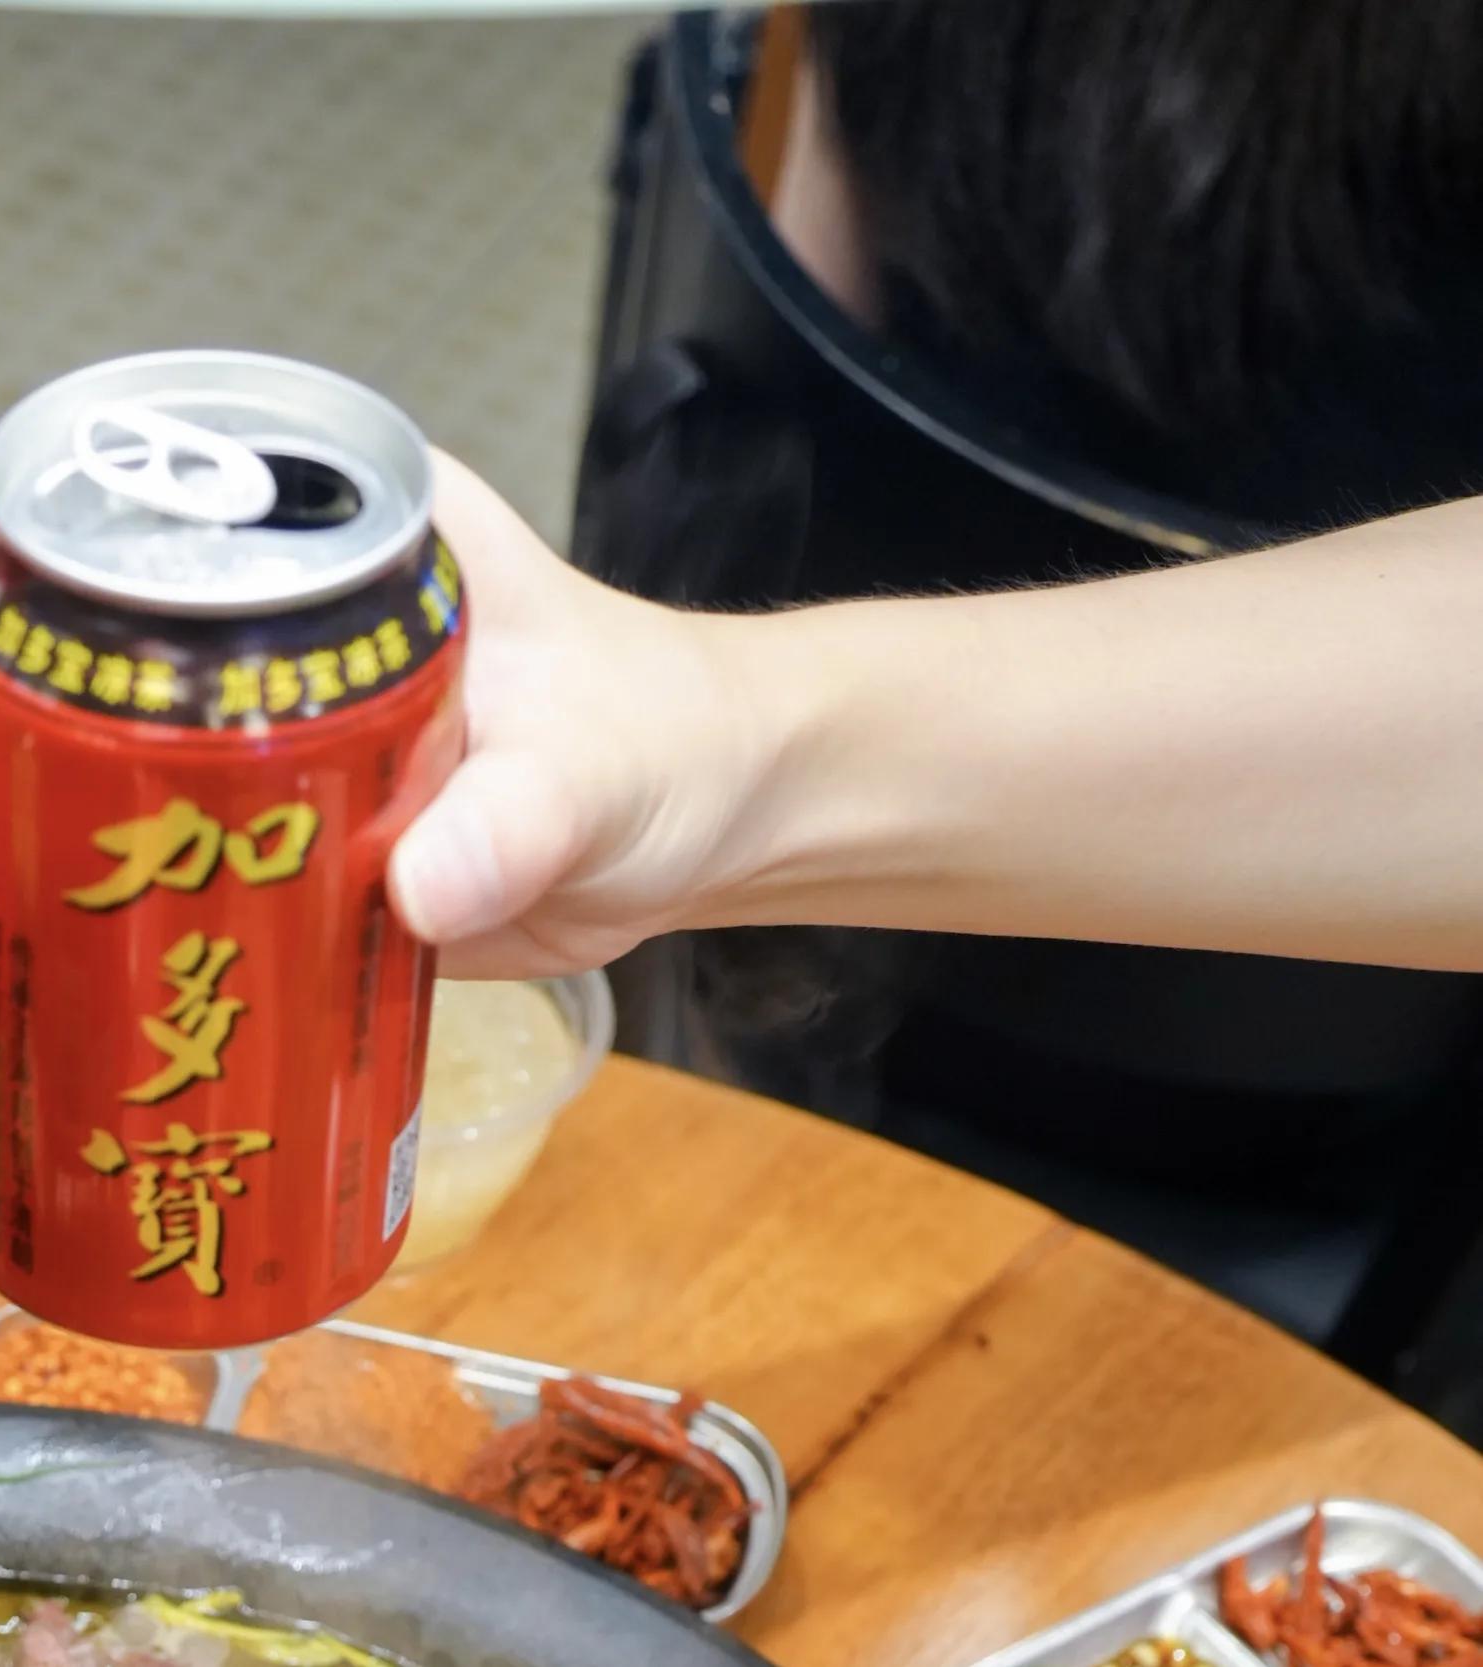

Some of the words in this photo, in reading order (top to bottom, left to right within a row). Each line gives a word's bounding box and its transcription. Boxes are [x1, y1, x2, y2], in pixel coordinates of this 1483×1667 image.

[219, 617, 412, 716] 加多宝凉茶
